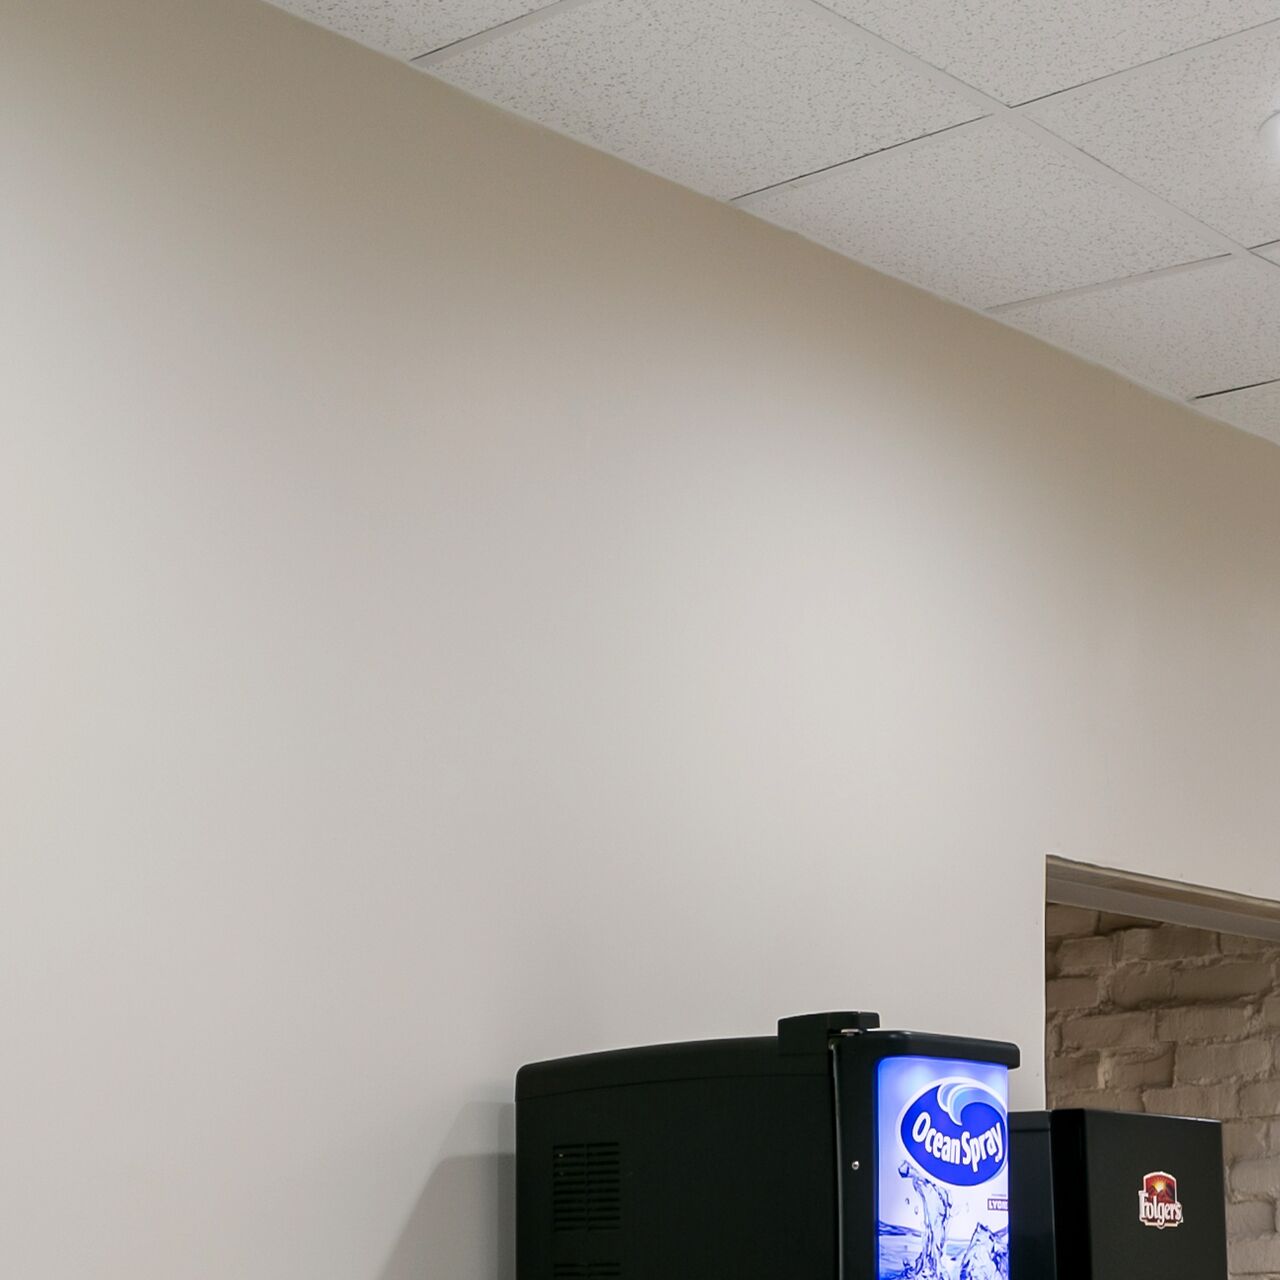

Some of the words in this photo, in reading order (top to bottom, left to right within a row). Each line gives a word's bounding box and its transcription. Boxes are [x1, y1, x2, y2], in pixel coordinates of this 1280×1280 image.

[912, 1111, 960, 1165] Ocean
[961, 1122, 1003, 1173] Spray
[1138, 1190, 1182, 1226] Folgers
